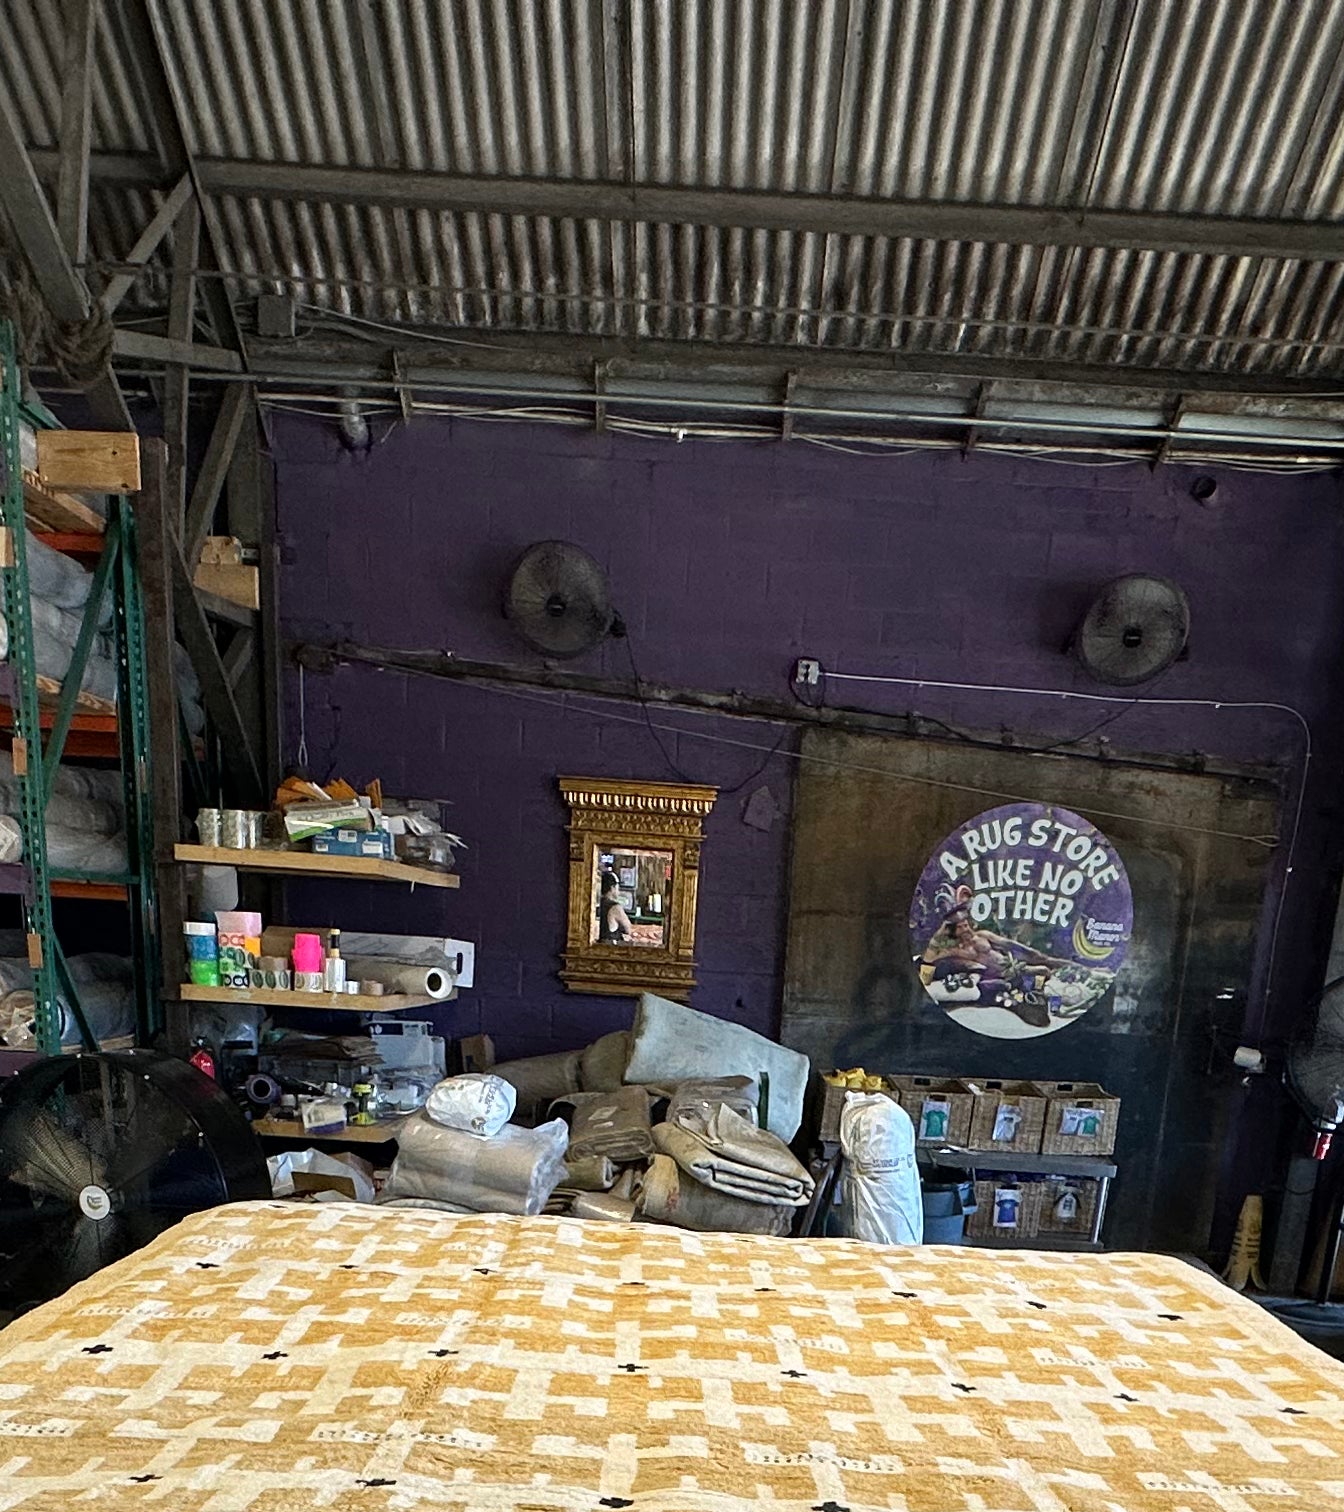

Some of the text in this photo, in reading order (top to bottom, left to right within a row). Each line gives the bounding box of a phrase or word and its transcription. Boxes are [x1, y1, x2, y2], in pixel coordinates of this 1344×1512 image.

[939, 816, 1120, 891] A RUG STORE
[971, 859, 1084, 895] LIKE NO
[970, 890, 1075, 928] OTHER
